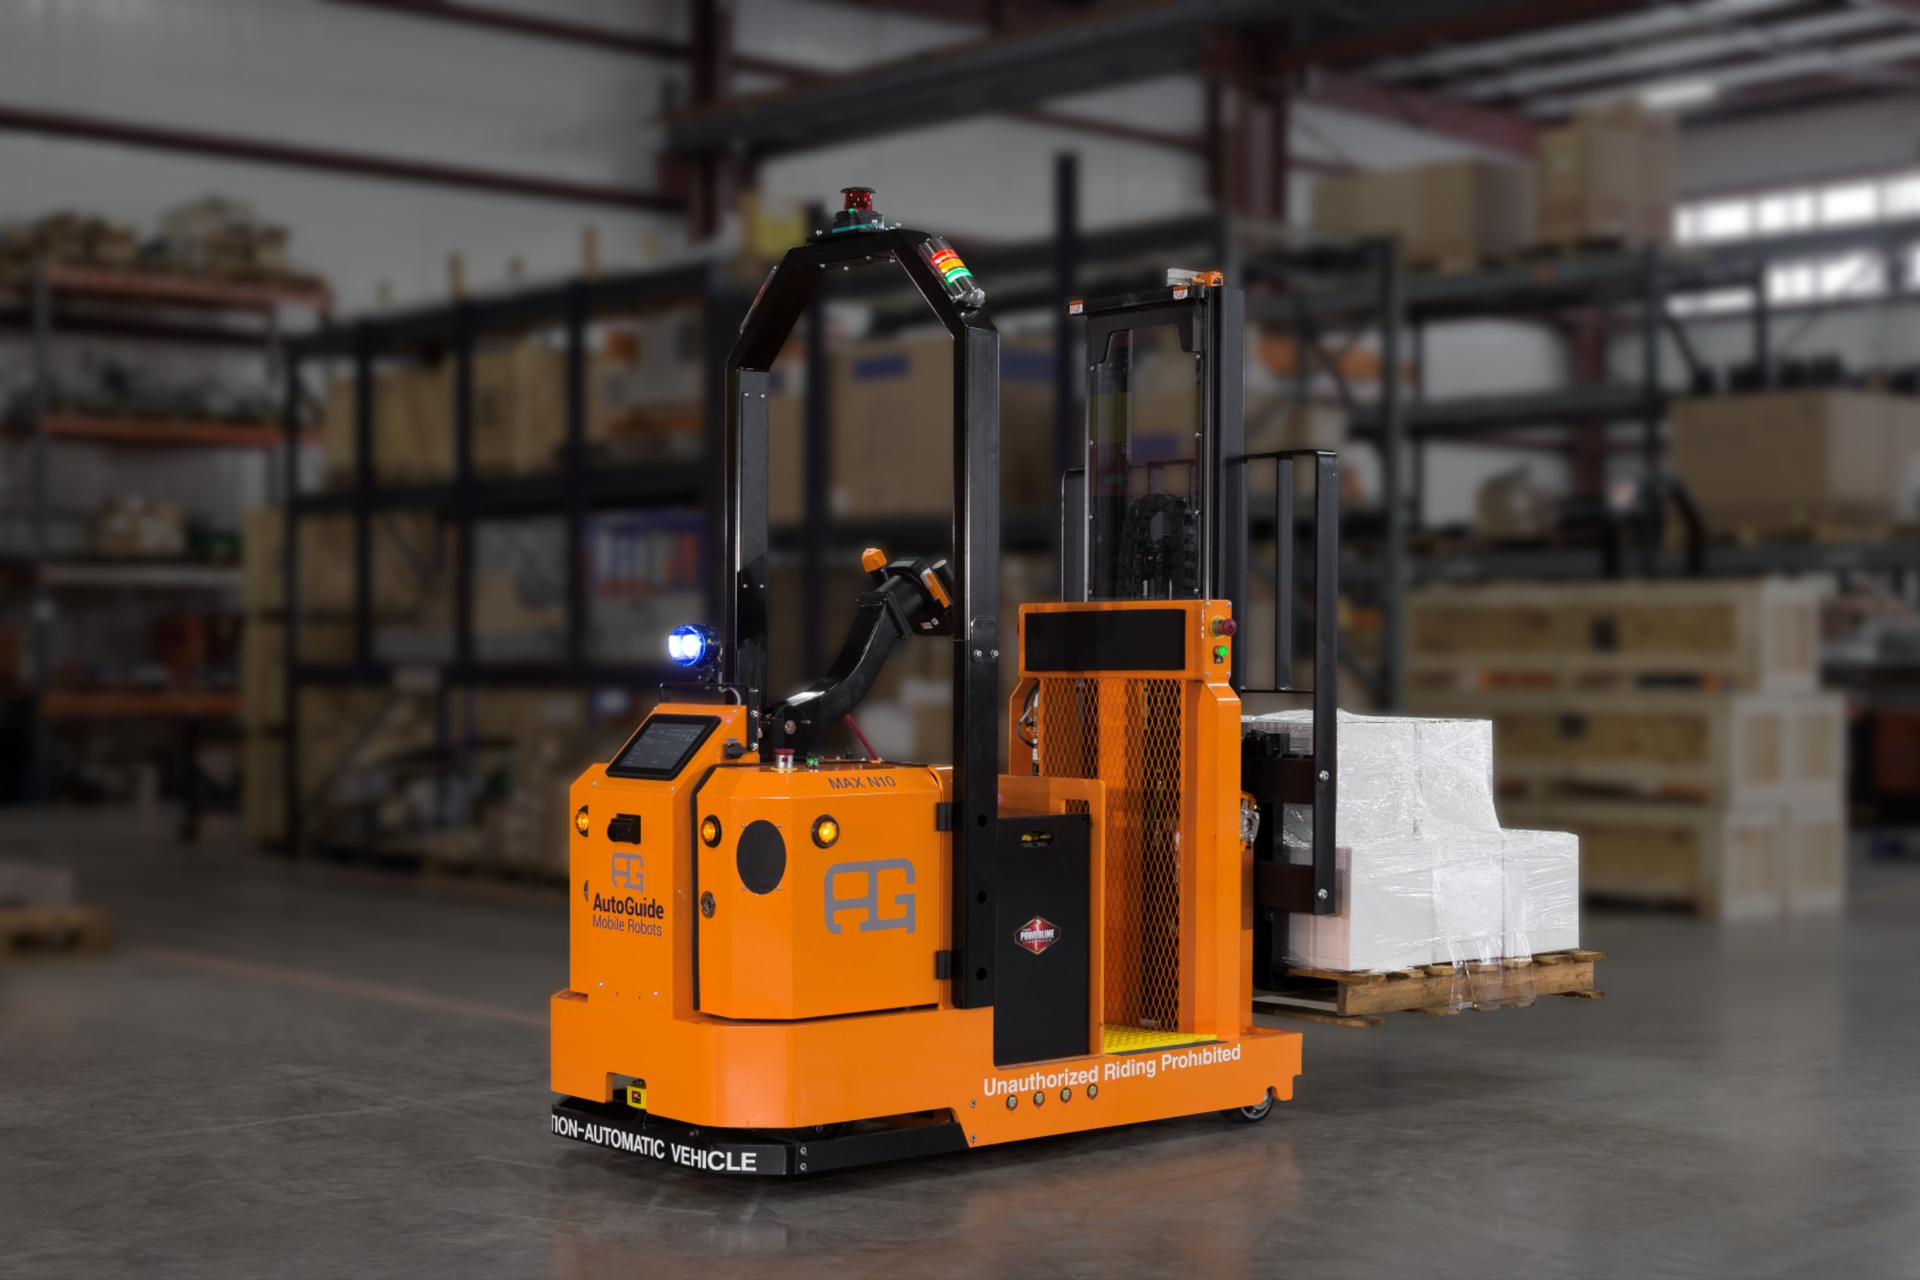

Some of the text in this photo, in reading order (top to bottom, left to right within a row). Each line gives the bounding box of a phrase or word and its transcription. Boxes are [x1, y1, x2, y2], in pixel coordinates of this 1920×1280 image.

[828, 776, 896, 789] MAX N10
[592, 892, 664, 919] AutoGuide
[592, 914, 663, 937] Mobile Robots
[1020, 929, 1055, 942] POWERLINE
[983, 1065, 1099, 1096] Unauthorized
[1104, 1058, 1156, 1081] Riding
[670, 1142, 757, 1172] VEHICLE
